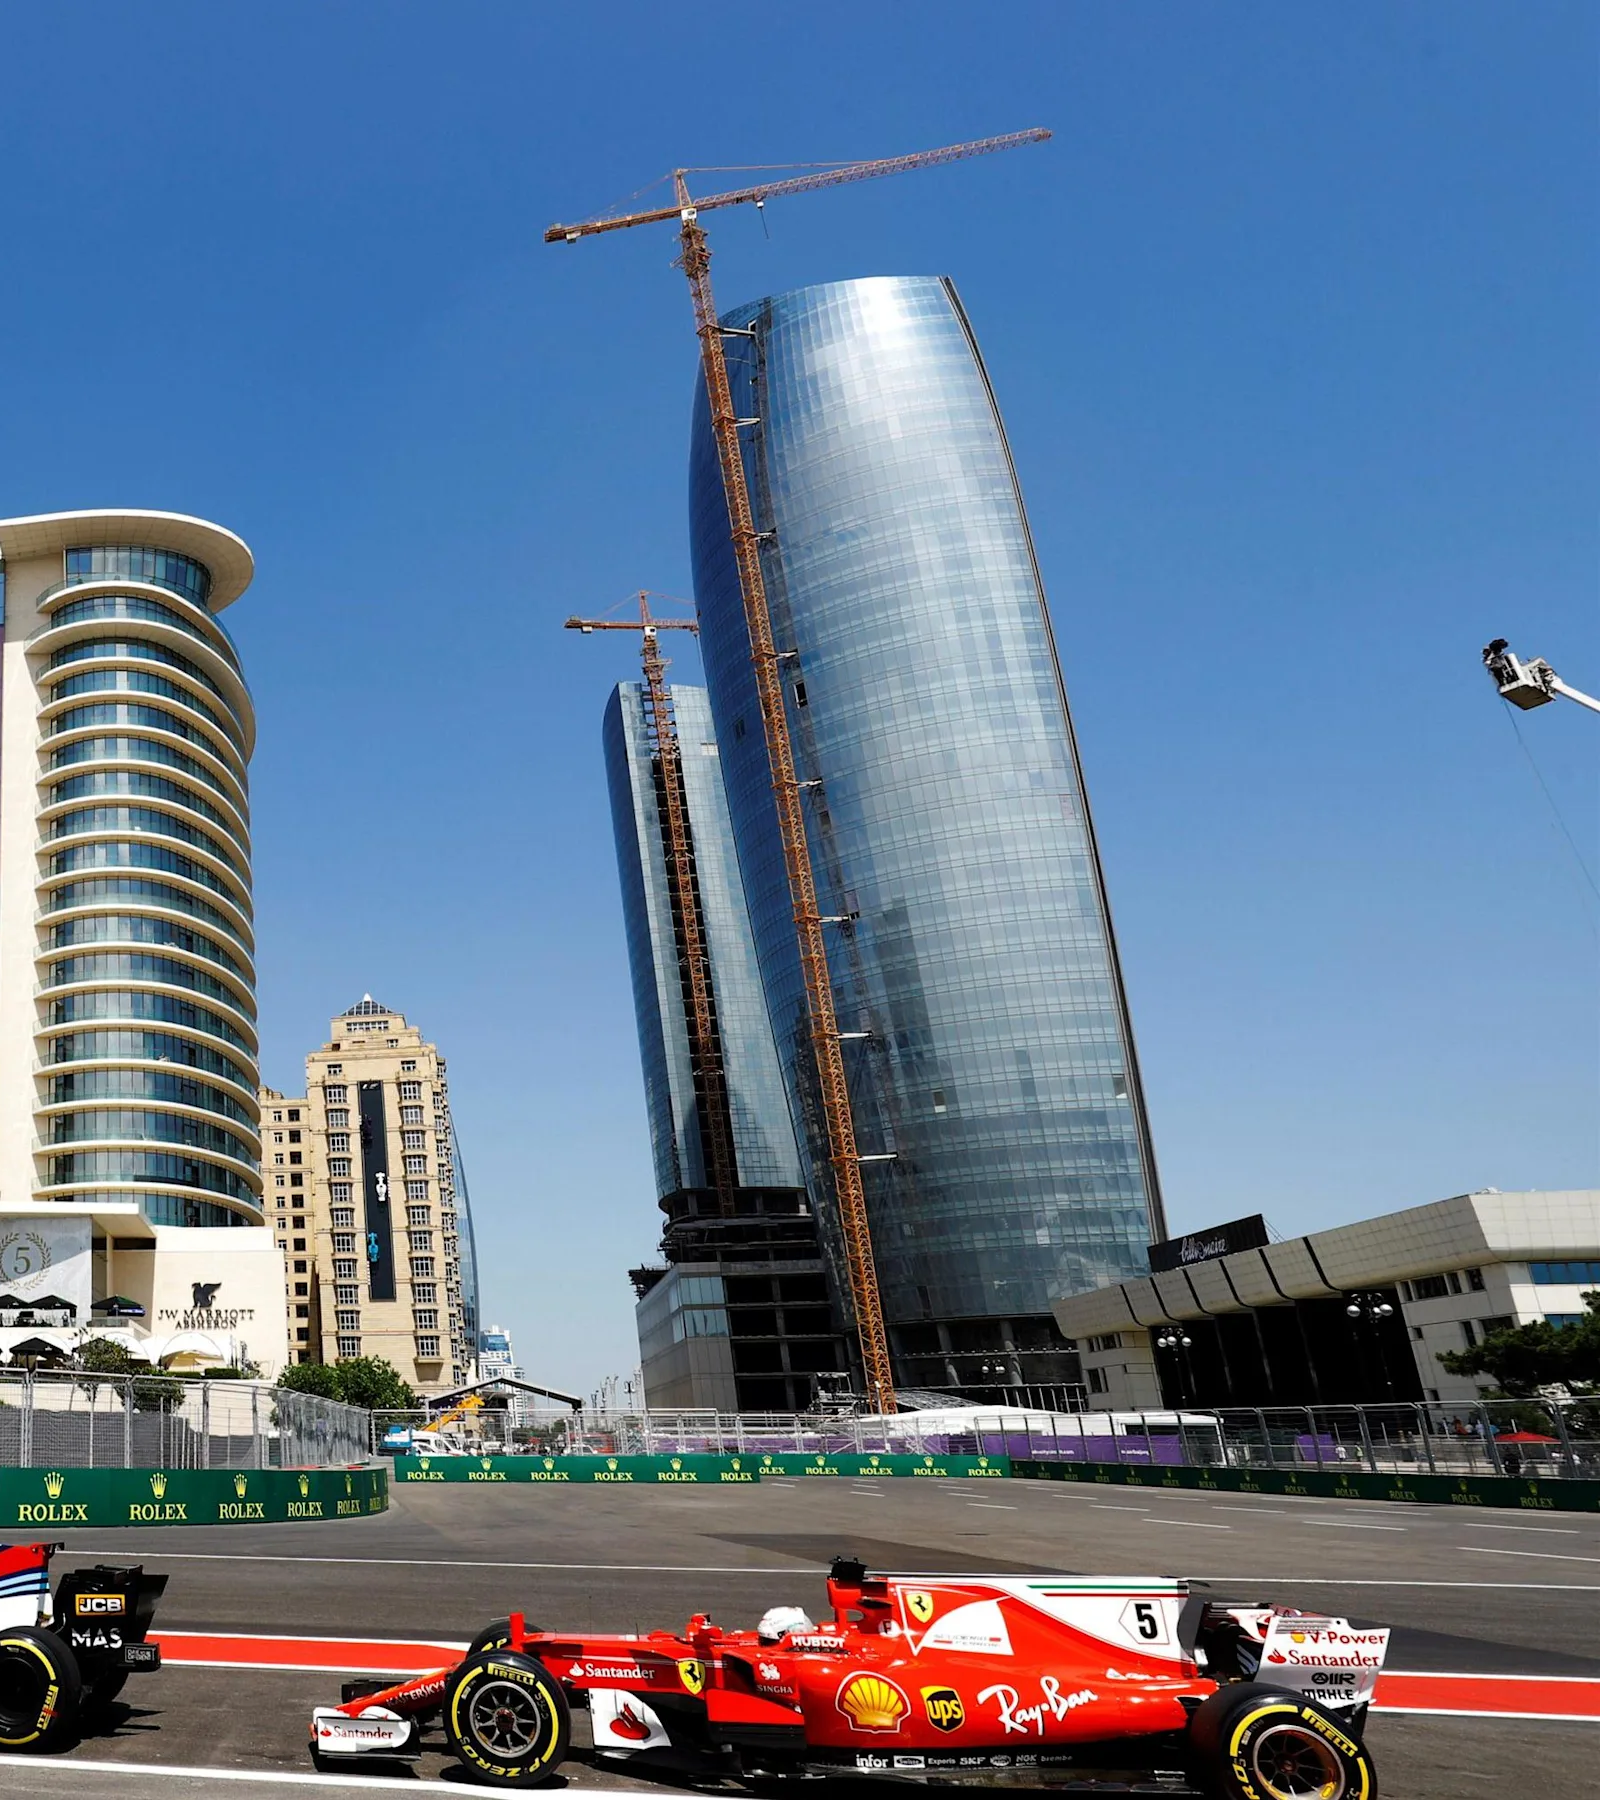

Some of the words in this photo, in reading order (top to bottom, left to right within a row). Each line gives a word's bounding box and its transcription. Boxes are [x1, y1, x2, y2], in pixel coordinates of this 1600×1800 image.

[13, 1247, 31, 1275] 5
[158, 1308, 181, 1321] JW
[184, 1307, 255, 1321] MARRIOTT
[175, 1319, 237, 1330] ABSHERON
[407, 1471, 445, 1480] ROLEX
[468, 1471, 507, 1481] ROLEX
[531, 1471, 569, 1481] ROLEX
[594, 1472, 634, 1481] ROLEX
[658, 1472, 697, 1481] ROLEX
[721, 1472, 753, 1481] ROLEX
[759, 1466, 785, 1475] OLEX
[805, 1467, 839, 1475] ROLEX
[859, 1467, 893, 1476] ROLEX
[913, 1468, 948, 1476] ROLEX
[968, 1468, 1002, 1477] ROLEX
[1284, 1485, 1307, 1494] ROLEX
[1335, 1488, 1360, 1498] ROLEX
[1388, 1490, 1418, 1500] ROLEX
[1451, 1493, 1483, 1504] ROLEX
[1520, 1496, 1555, 1508] ROLEX
[18, 1503, 88, 1522] ROLEX
[129, 1503, 188, 1521] ROLEX
[218, 1502, 265, 1520] ROLEX
[287, 1501, 323, 1518] ROLEX
[337, 1500, 360, 1515] ROLEX
[79, 1598, 122, 1612] JCB
[1134, 1603, 1158, 1639] 5
[791, 1635, 846, 1648] HUBLOT
[1309, 1630, 1386, 1645] V-Power
[1288, 1650, 1381, 1667] Santander
[488, 1662, 535, 1685] PIRELLI
[585, 1662, 655, 1679] Santander
[756, 1684, 793, 1694] SINGHA
[1301, 1688, 1354, 1700] MAHLE
[927, 1697, 963, 1726] ups
[333, 1725, 394, 1739] Santander
[1301, 1706, 1358, 1757] PIRELLI
[461, 1745, 521, 1777] ZERO
[855, 1754, 888, 1768] infor
[960, 1757, 986, 1766] SKF
